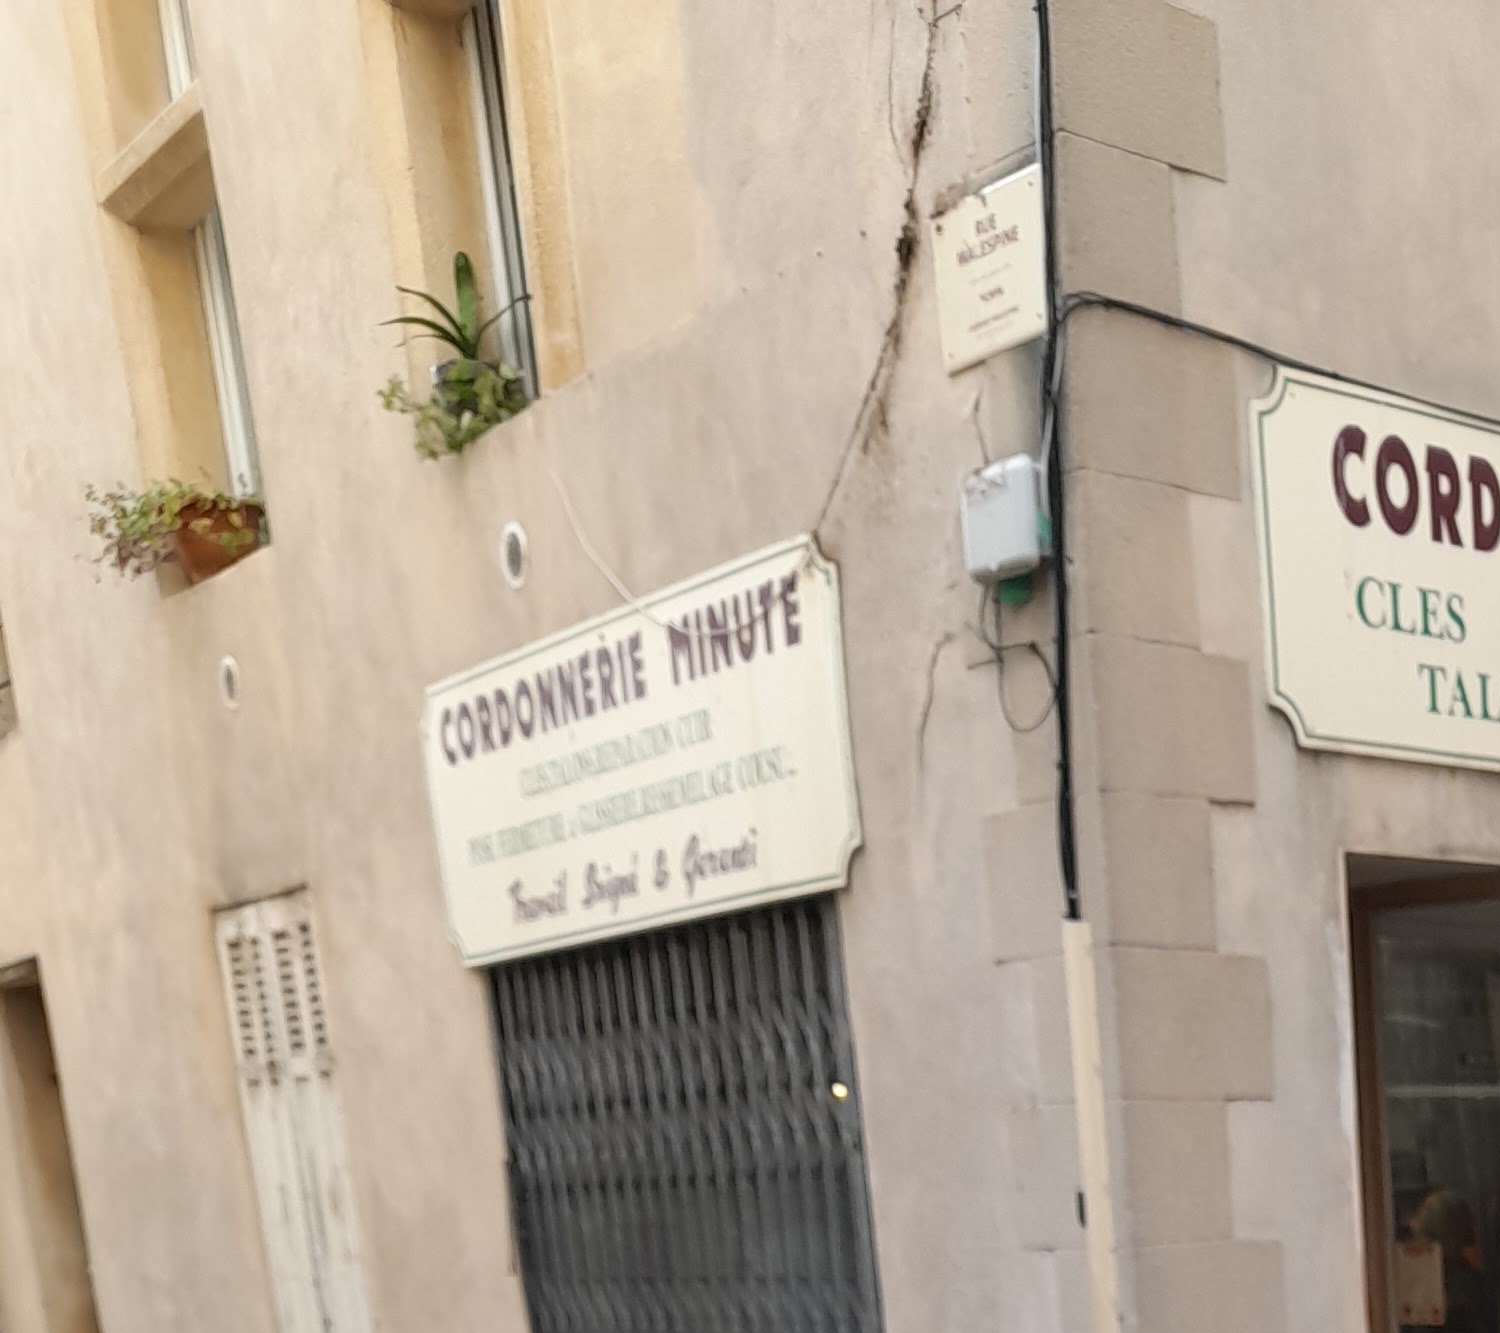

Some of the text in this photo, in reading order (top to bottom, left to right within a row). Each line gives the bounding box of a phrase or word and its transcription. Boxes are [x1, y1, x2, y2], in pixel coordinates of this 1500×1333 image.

[439, 630, 647, 767] CORDONNERIE
[666, 569, 802, 686] MINUTE
[1355, 575, 1467, 643] CLES
